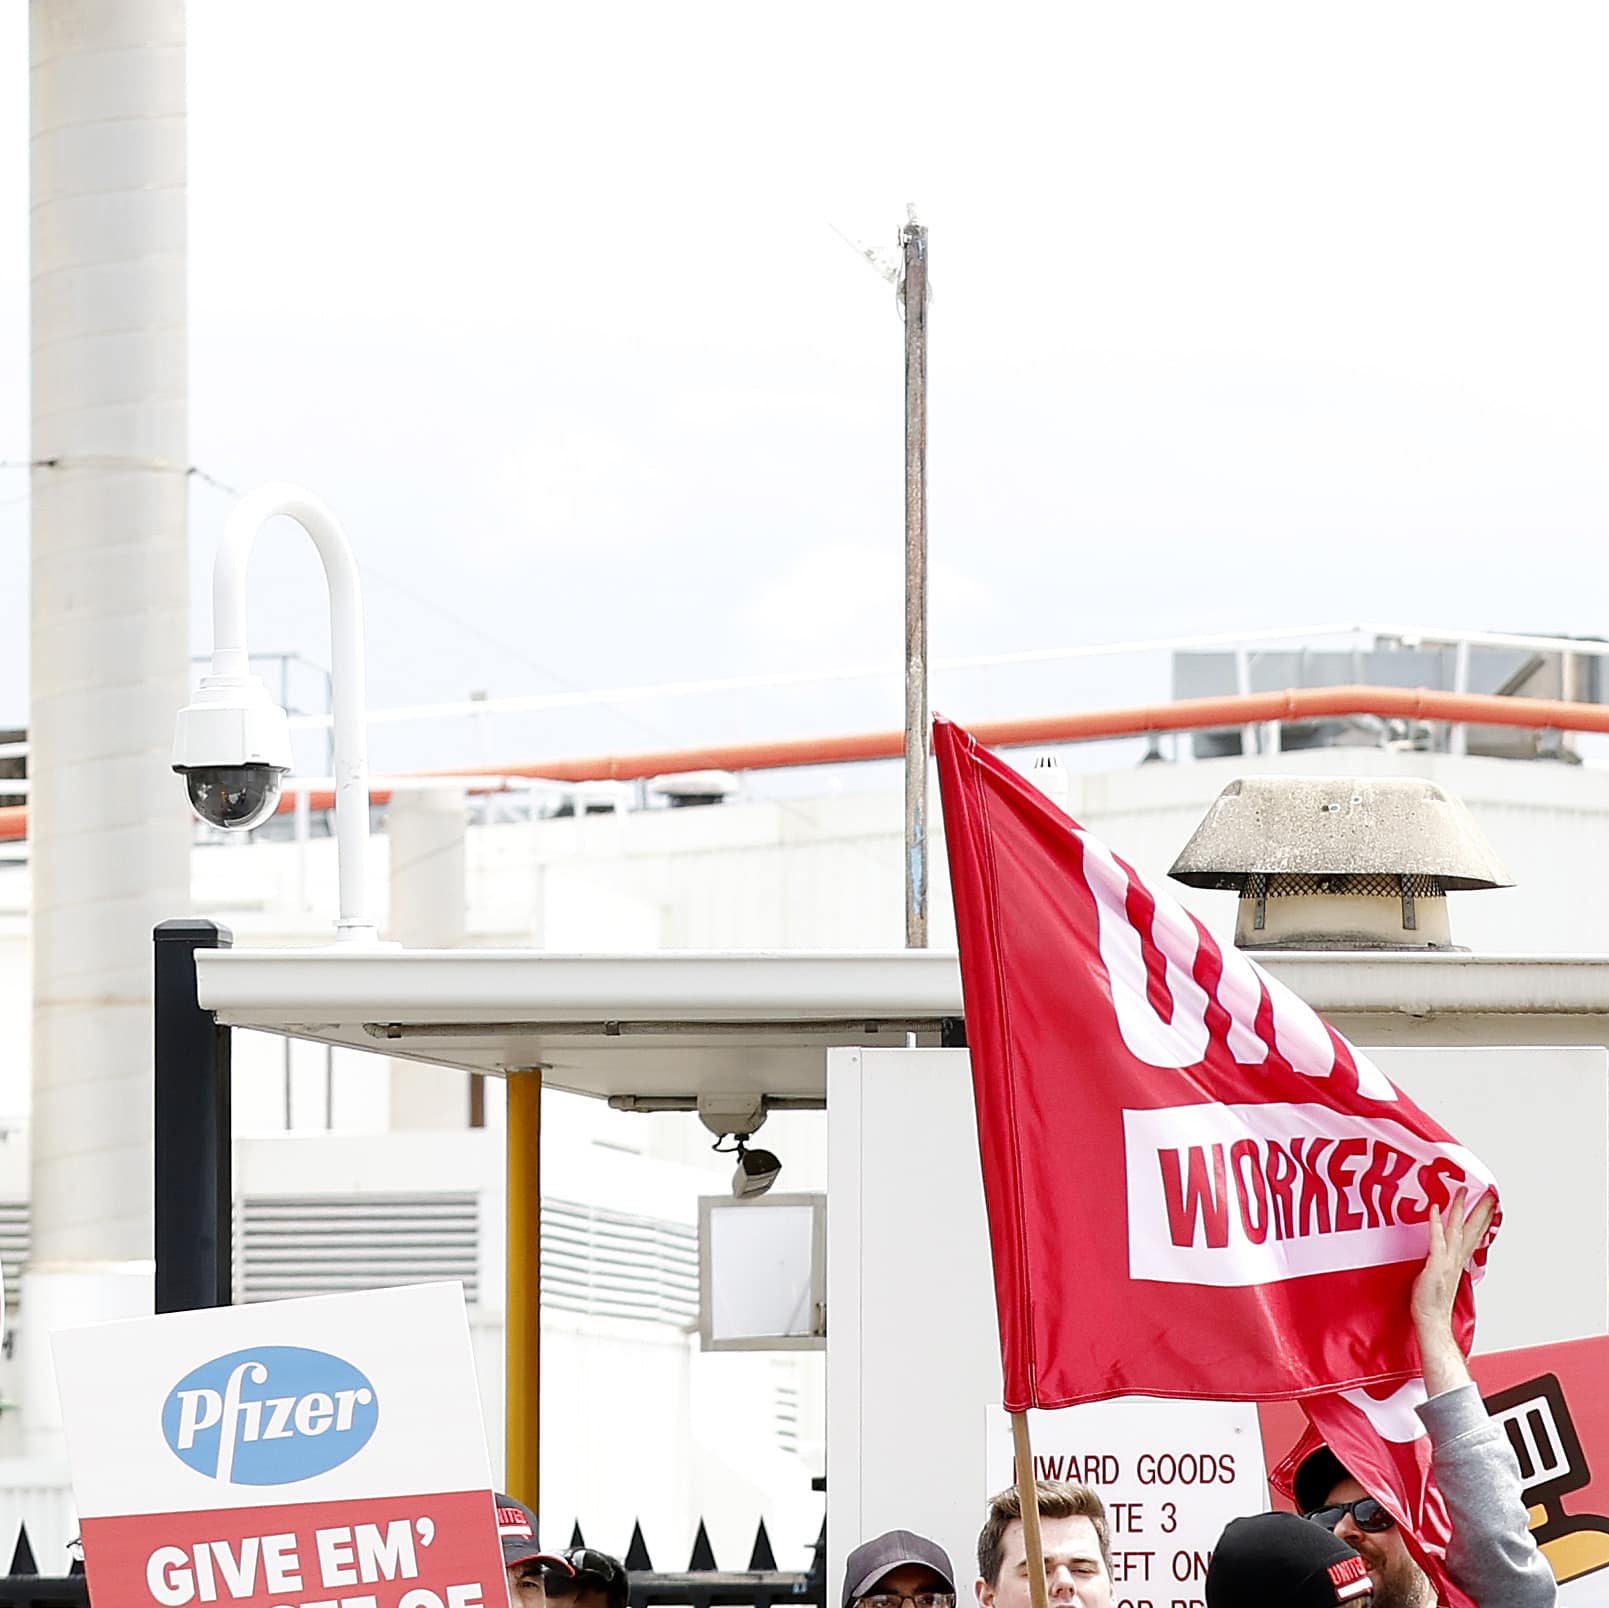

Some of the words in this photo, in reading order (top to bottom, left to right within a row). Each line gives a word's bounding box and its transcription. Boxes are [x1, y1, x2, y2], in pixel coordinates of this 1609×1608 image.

[1158, 1136, 1466, 1248] WORKERS
[177, 1362, 372, 1482] Pfizer
[1014, 1456, 1119, 1485] IWARD
[1137, 1454, 1236, 1485] GOODS
[1161, 1502, 1177, 1533] 3
[146, 1533, 303, 1608] GIVE
[1112, 1552, 1155, 1581] EFT
